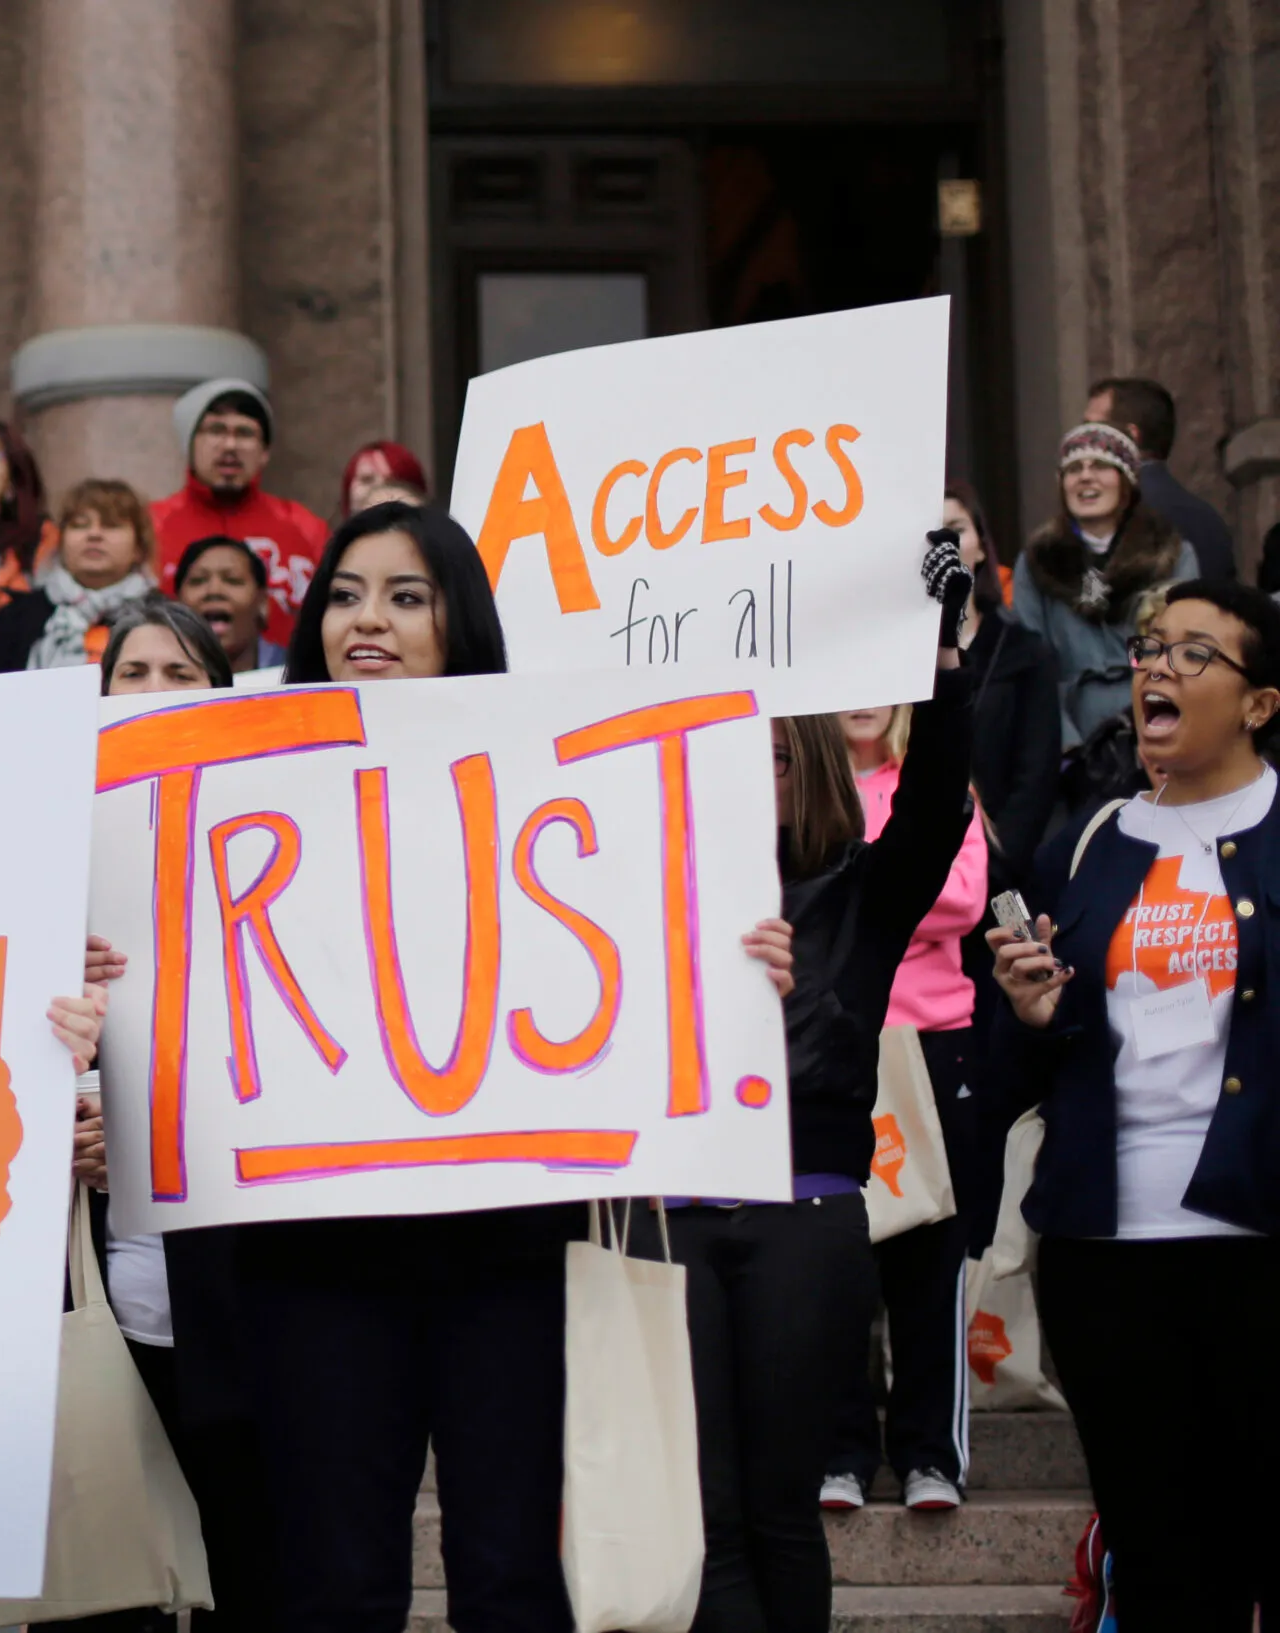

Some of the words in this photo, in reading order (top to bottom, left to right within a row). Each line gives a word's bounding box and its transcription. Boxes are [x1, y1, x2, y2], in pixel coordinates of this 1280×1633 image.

[476, 421, 865, 615] ACCESS
[609, 578, 698, 666] for
[728, 559, 793, 668] all
[94, 687, 772, 1203] TRUST.
[1124, 903, 1195, 925] TRUST.
[1134, 921, 1236, 949] RESPECT.
